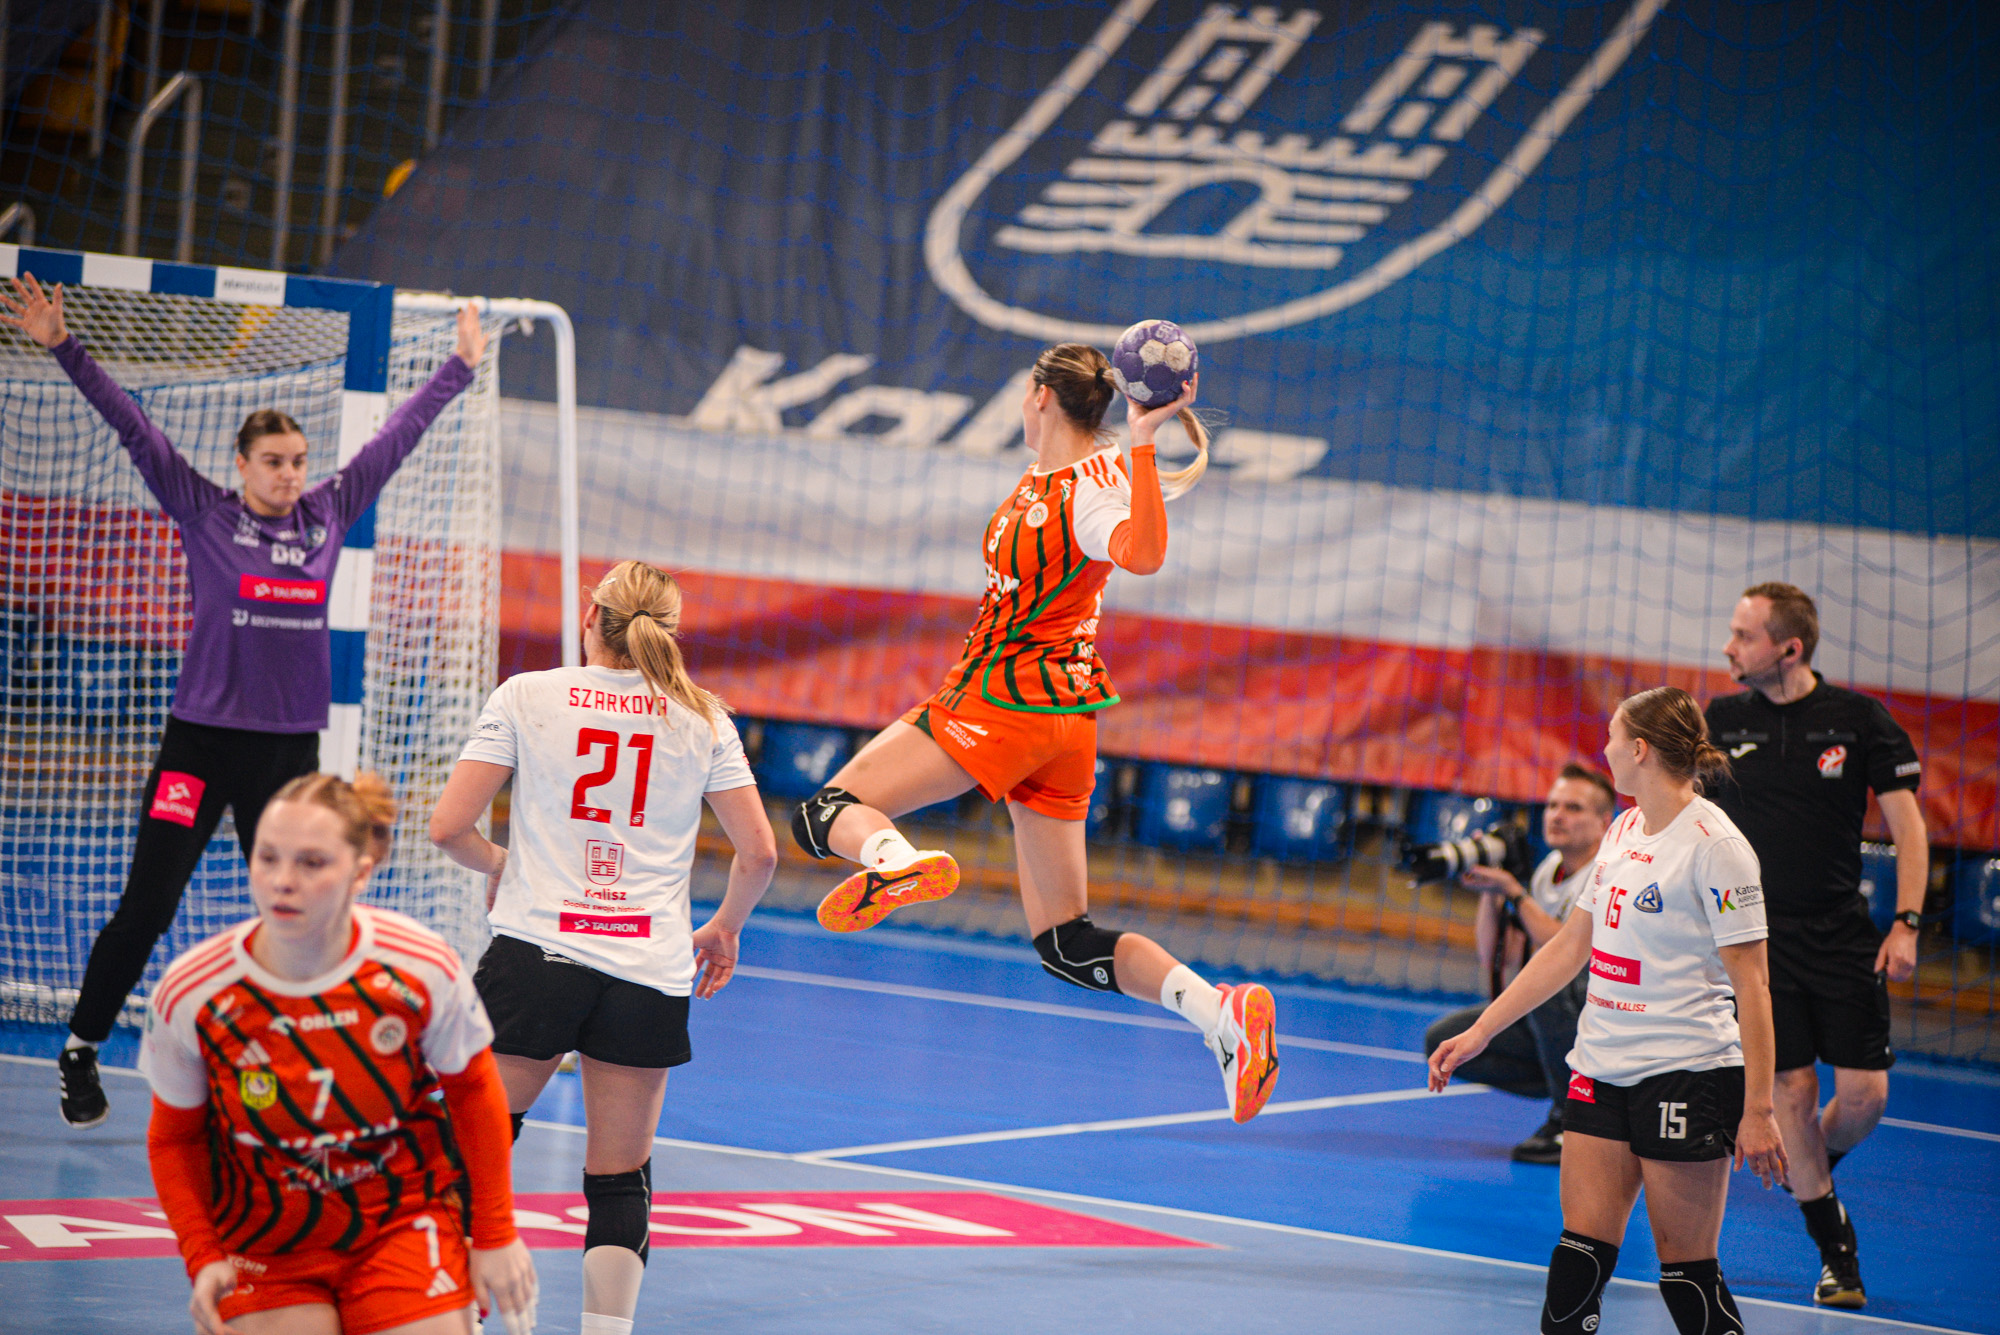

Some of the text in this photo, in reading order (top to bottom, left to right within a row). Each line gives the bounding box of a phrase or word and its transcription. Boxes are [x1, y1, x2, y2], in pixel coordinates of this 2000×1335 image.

[690, 345, 1329, 482] Kalz
[570, 727, 654, 827] 21
[585, 888, 627, 901] Kalisz
[1605, 886, 1628, 929] 15
[591, 921, 639, 933] TAURON
[299, 1009, 360, 1033] ORLEN
[1616, 1001, 1647, 1012] KALISZ
[307, 1067, 335, 1121] 7
[1658, 1101, 1688, 1140] 15
[0, 1203, 1017, 1249] AON
[413, 1213, 442, 1268] 7
